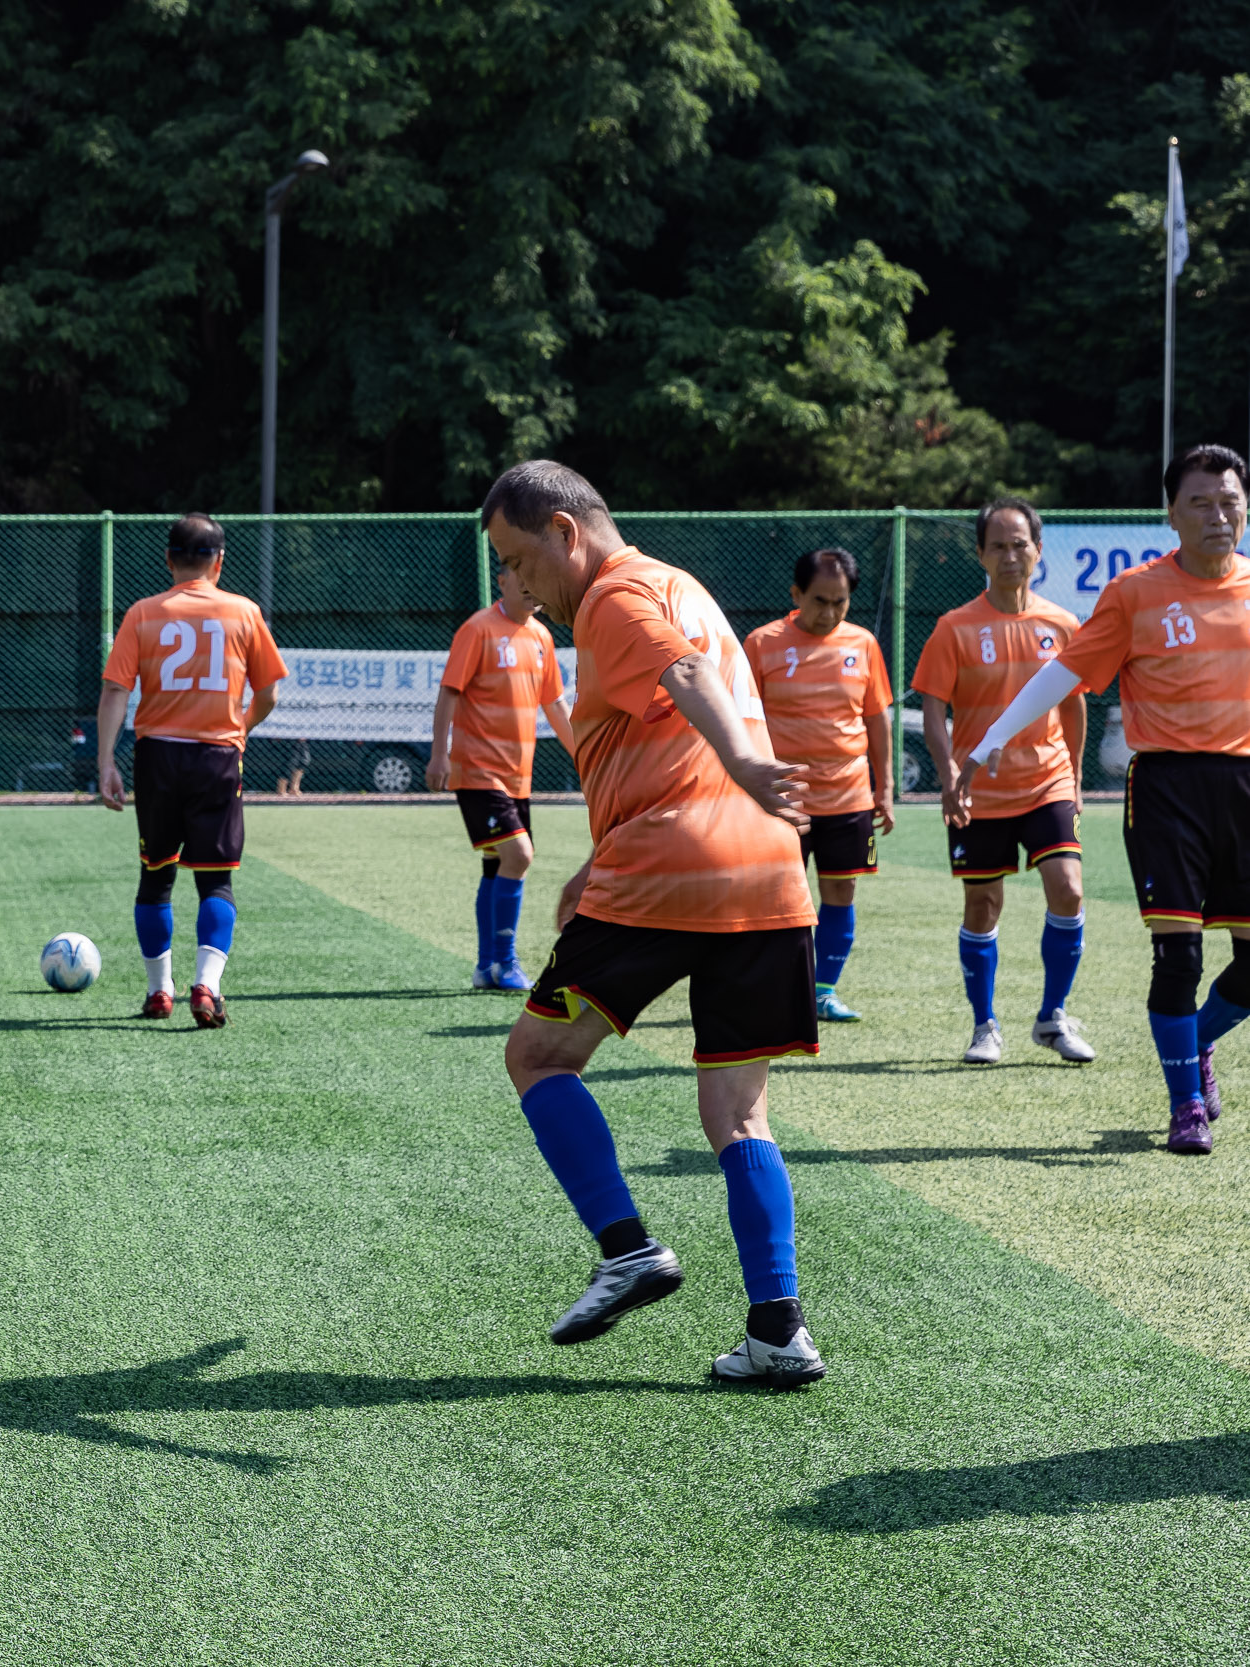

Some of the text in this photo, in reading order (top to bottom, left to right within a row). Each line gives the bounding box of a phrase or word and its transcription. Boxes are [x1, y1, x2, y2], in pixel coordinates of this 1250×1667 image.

[1161, 615, 1197, 649] 13
[159, 619, 229, 692] 21
[497, 645, 518, 668] 18
[981, 638, 997, 665] 8
[785, 657, 800, 678] 7
